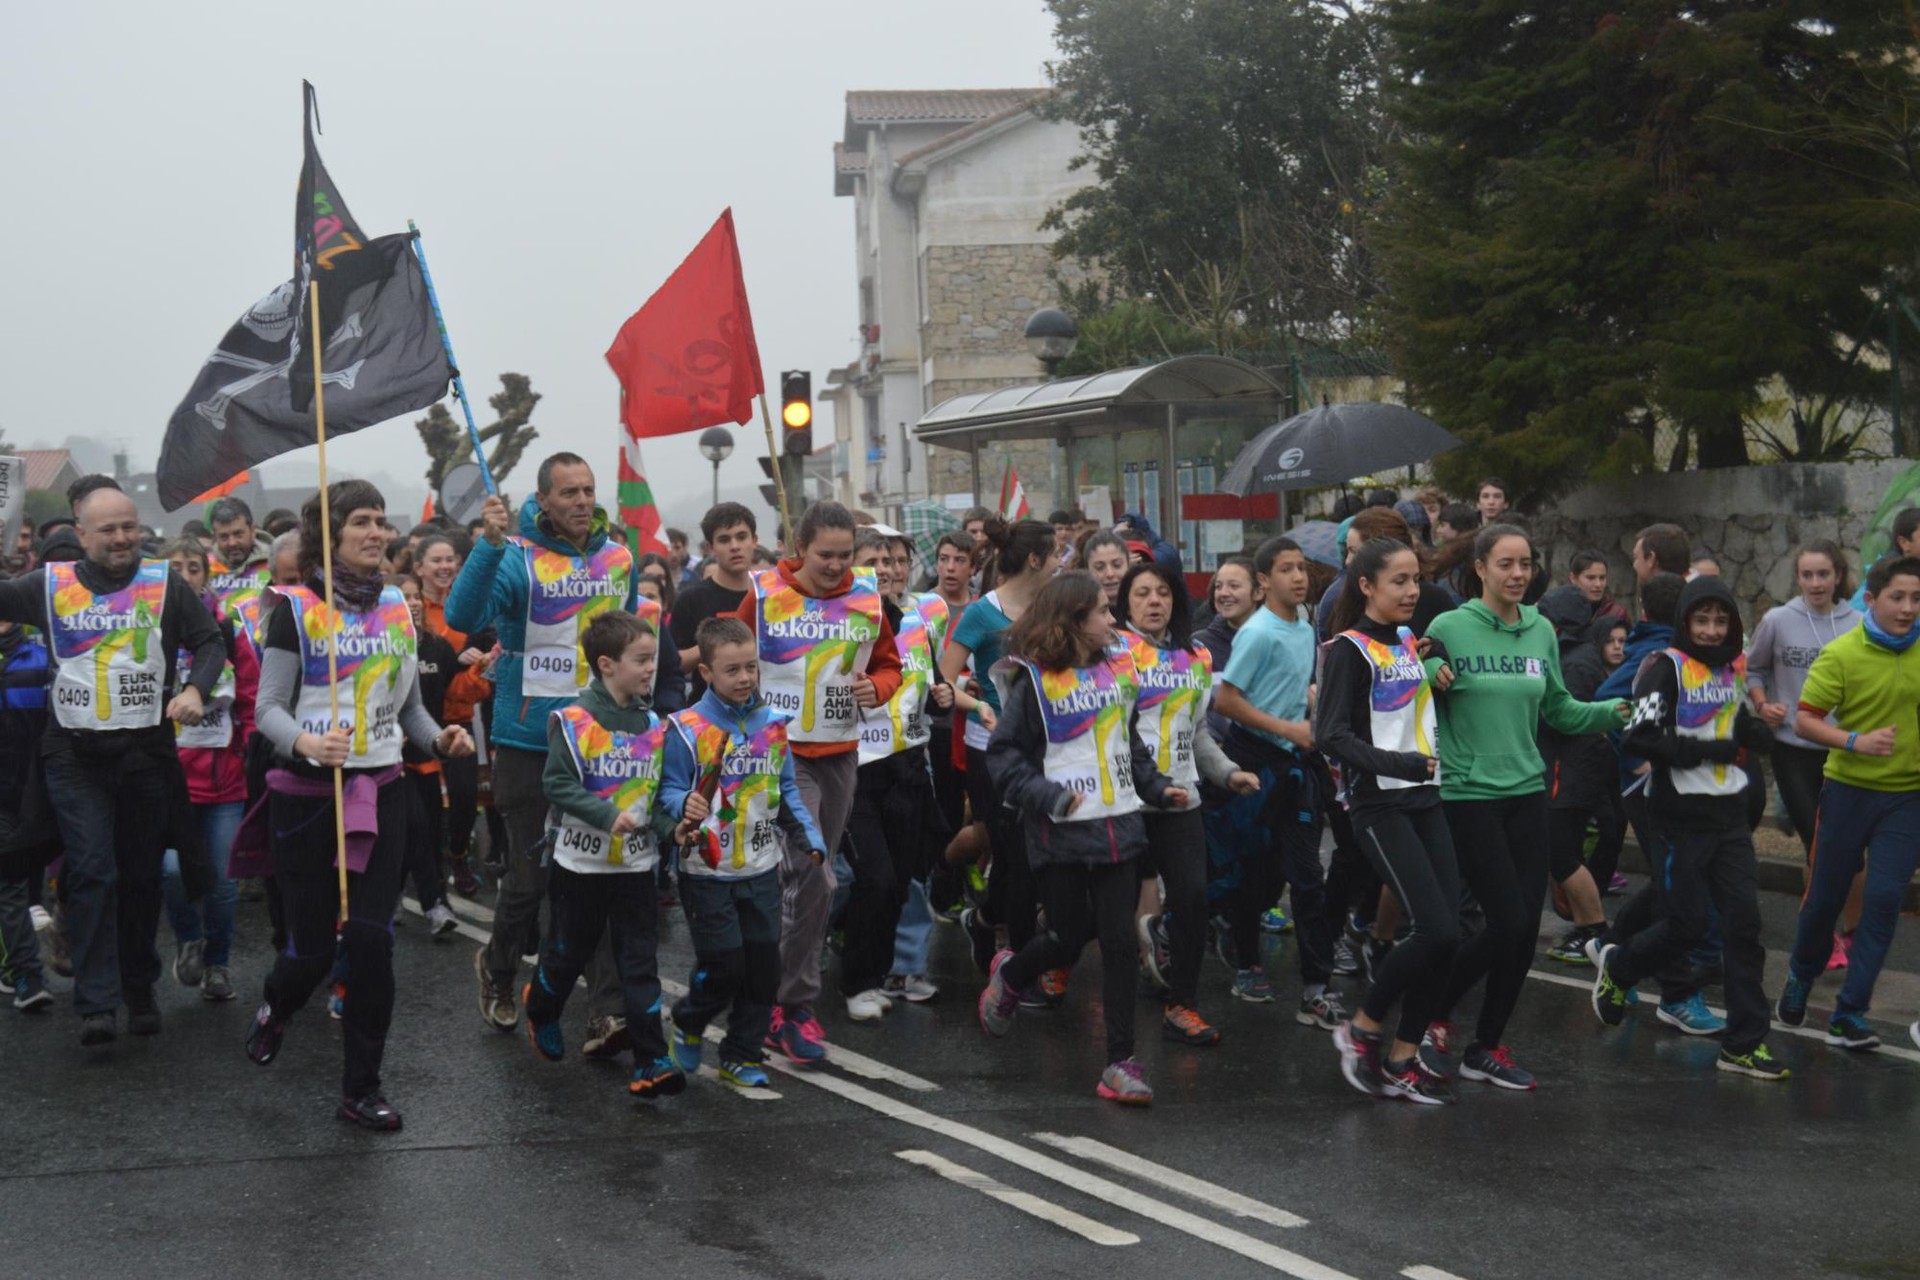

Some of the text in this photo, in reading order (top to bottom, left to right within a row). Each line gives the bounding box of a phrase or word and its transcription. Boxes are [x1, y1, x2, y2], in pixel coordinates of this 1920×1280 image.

[1263, 469, 1311, 482] INESIS
[541, 574, 629, 598] 19.korrika
[801, 608, 824, 622] aek
[767, 614, 871, 642] 19.korrika
[309, 630, 408, 657] 19korrika
[530, 655, 573, 673] 0409
[119, 671, 158, 684] EUSK
[58, 687, 91, 707] 0409
[119, 684, 156, 695] AHAL
[765, 691, 801, 710] 0409
[861, 729, 890, 743] 409
[562, 827, 602, 856] 0409
